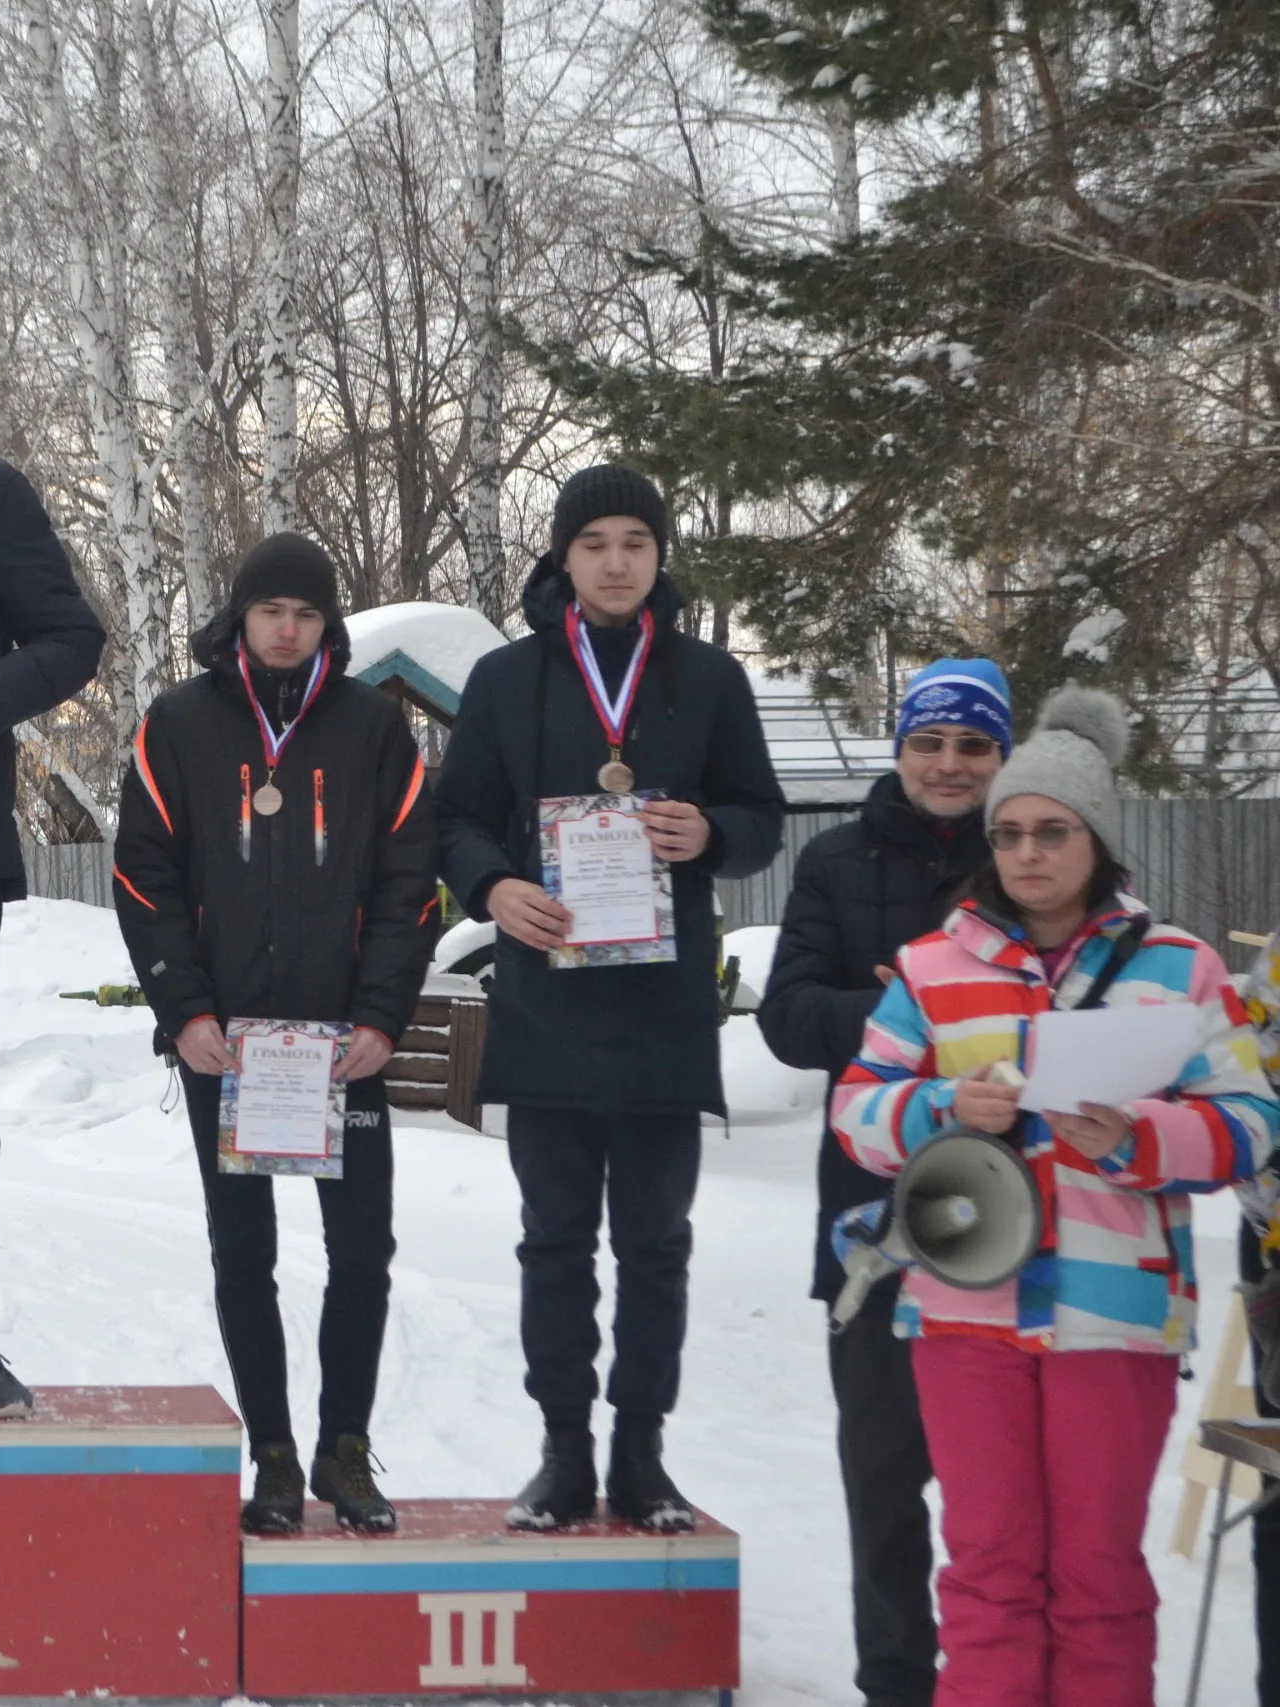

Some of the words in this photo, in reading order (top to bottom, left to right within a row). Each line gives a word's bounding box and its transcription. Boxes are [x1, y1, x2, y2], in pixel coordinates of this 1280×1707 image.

[568, 831, 642, 845] ГРАМОТА
[251, 1047, 322, 1060] ГРАМОТА
[417, 1591, 531, 1687] III
